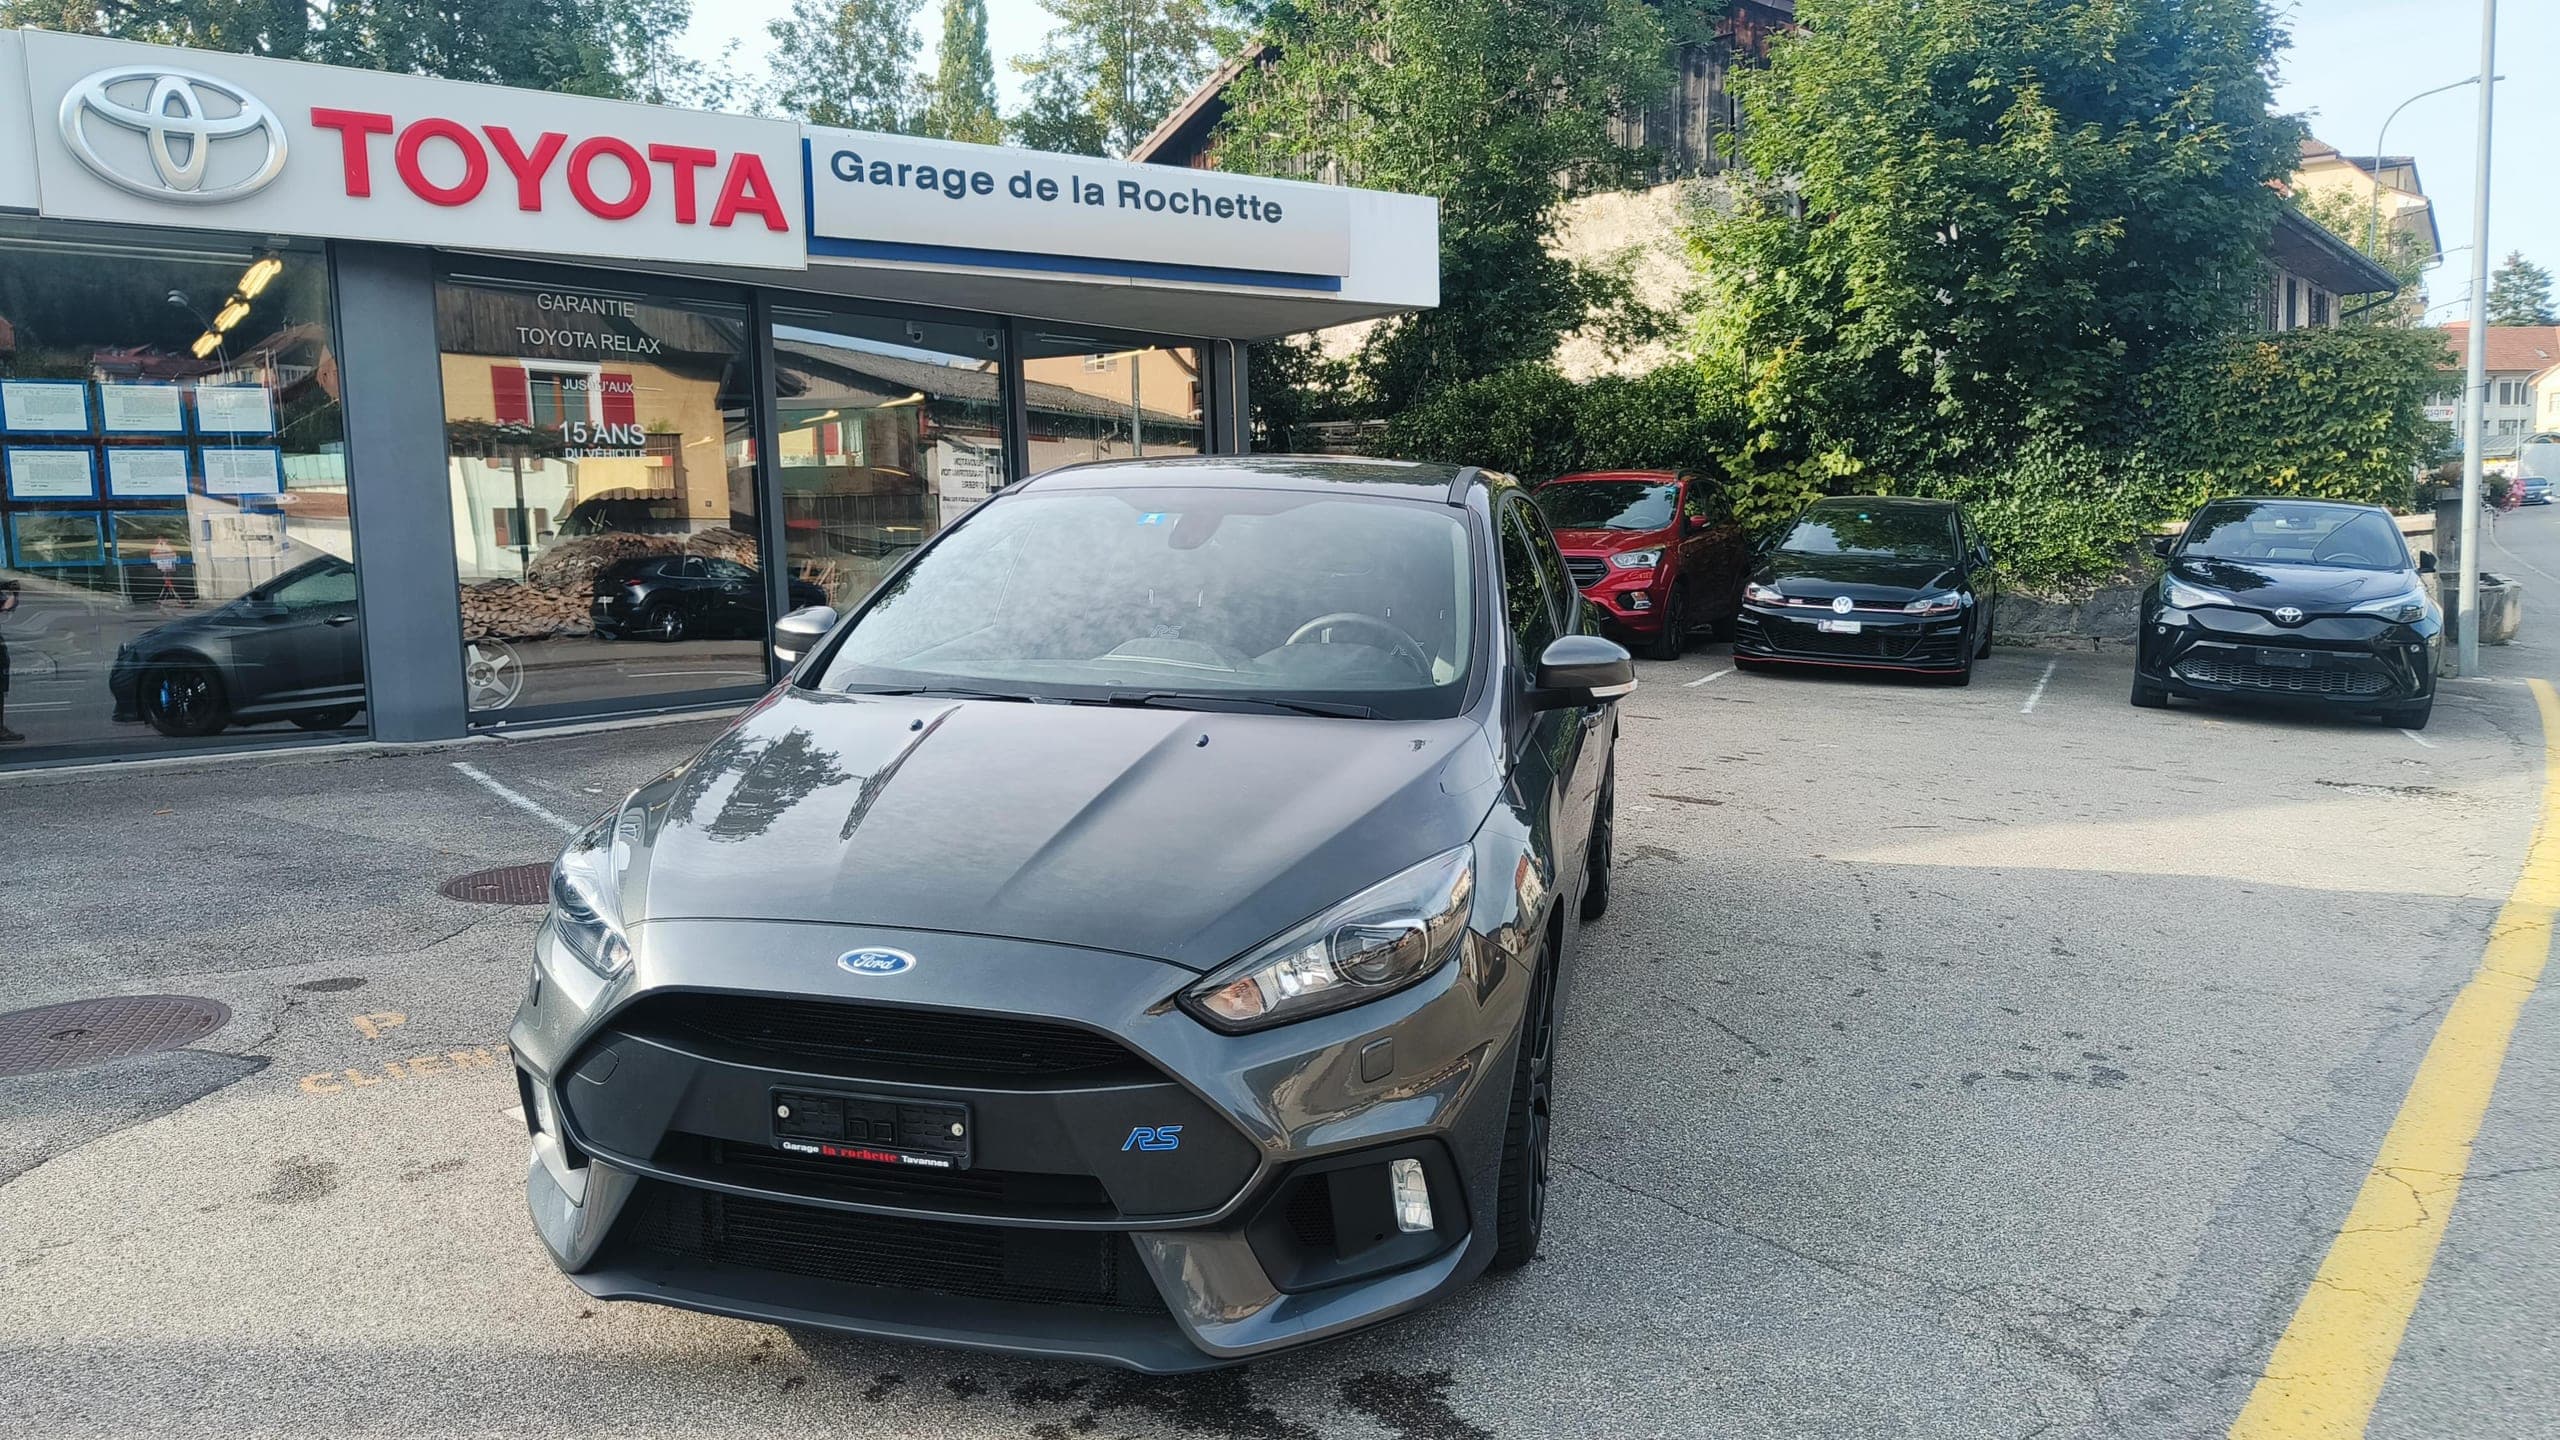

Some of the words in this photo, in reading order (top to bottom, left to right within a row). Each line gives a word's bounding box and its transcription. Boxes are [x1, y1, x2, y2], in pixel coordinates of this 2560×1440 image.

[310, 106, 790, 233] TOYOTA
[830, 149, 995, 200] Garage
[1008, 169, 1059, 202] de
[1073, 175, 1104, 207] la
[1118, 180, 1283, 223] Rochette
[536, 292, 636, 319] GARANTIE
[516, 326, 597, 350] TOYOTA
[601, 333, 661, 355] RELAX
[562, 378, 634, 394] JUSQU'AUX
[559, 420, 588, 443] 15
[592, 422, 646, 446] ANS
[564, 447, 583, 459] DU
[853, 952, 897, 970] Ford
[354, 1011, 407, 1040] P
[1121, 1125, 1184, 1151] RS
[783, 1141, 819, 1154] Garage
[822, 1145, 837, 1157] la
[901, 1155, 950, 1168] Tavannes
